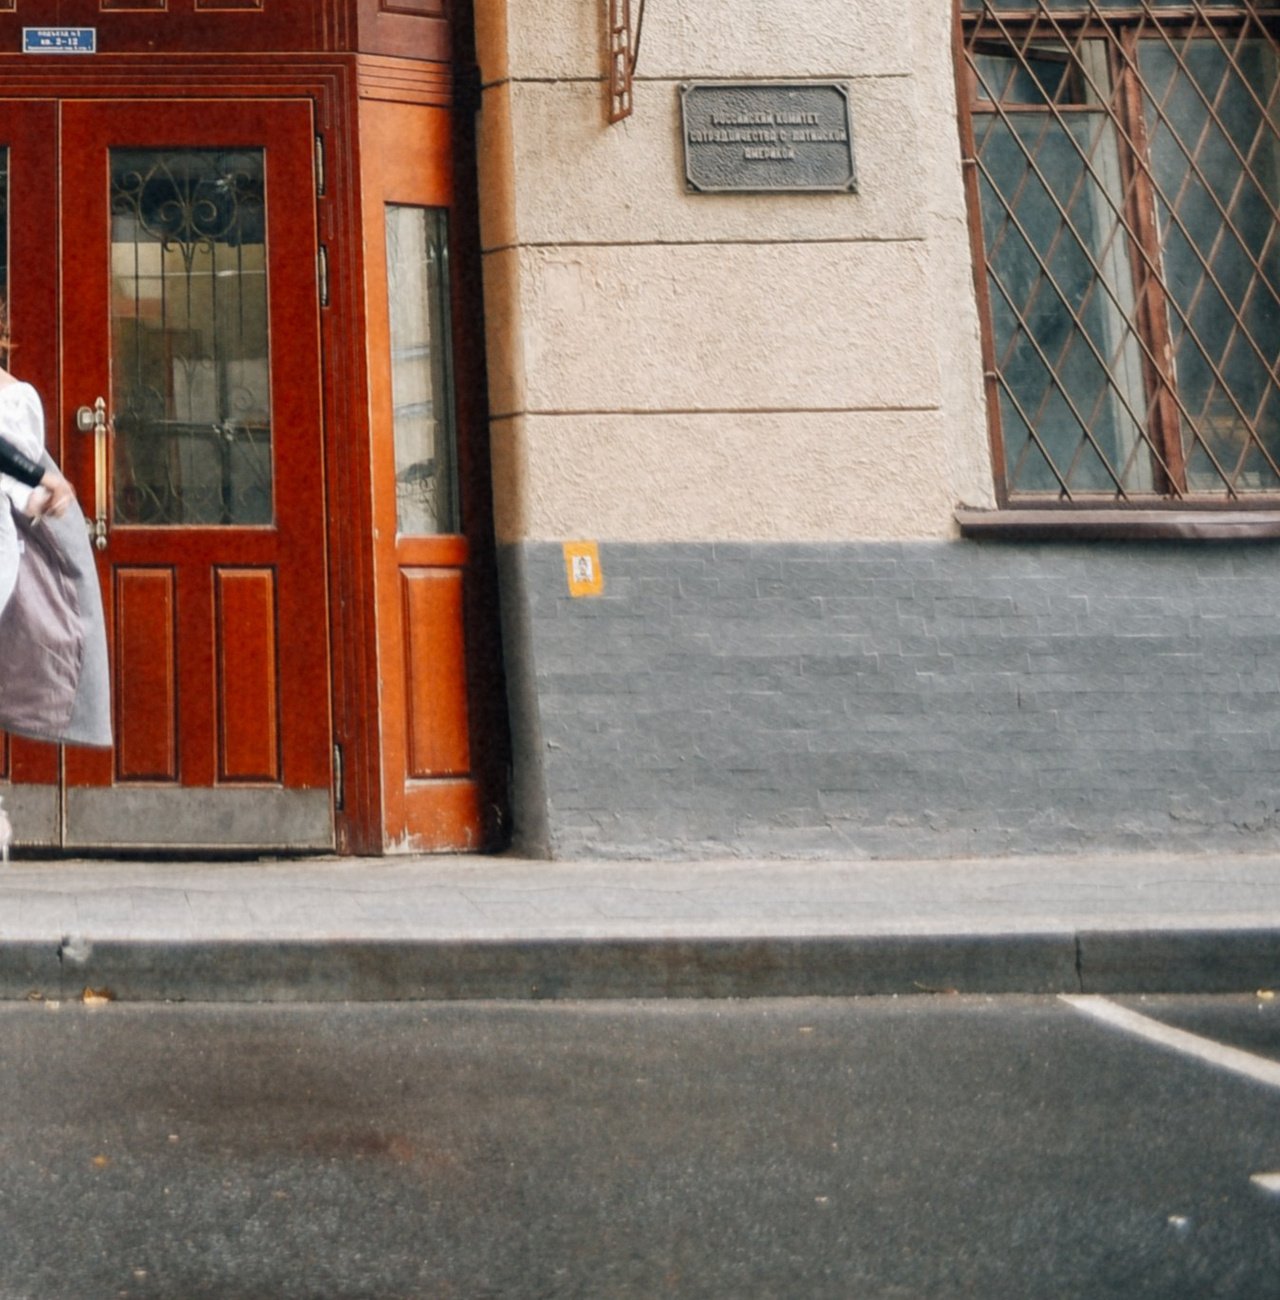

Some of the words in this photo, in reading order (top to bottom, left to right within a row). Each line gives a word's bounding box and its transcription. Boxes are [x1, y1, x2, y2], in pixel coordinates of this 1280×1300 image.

[712, 110, 773, 125] РОССИЙСКИЙ
[775, 112, 819, 125] КОМИТЕТ
[779, 130, 787, 142] С
[793, 128, 847, 143] ЛАТИНСКОЙ
[744, 146, 795, 160] АМЕРИКОЙ
